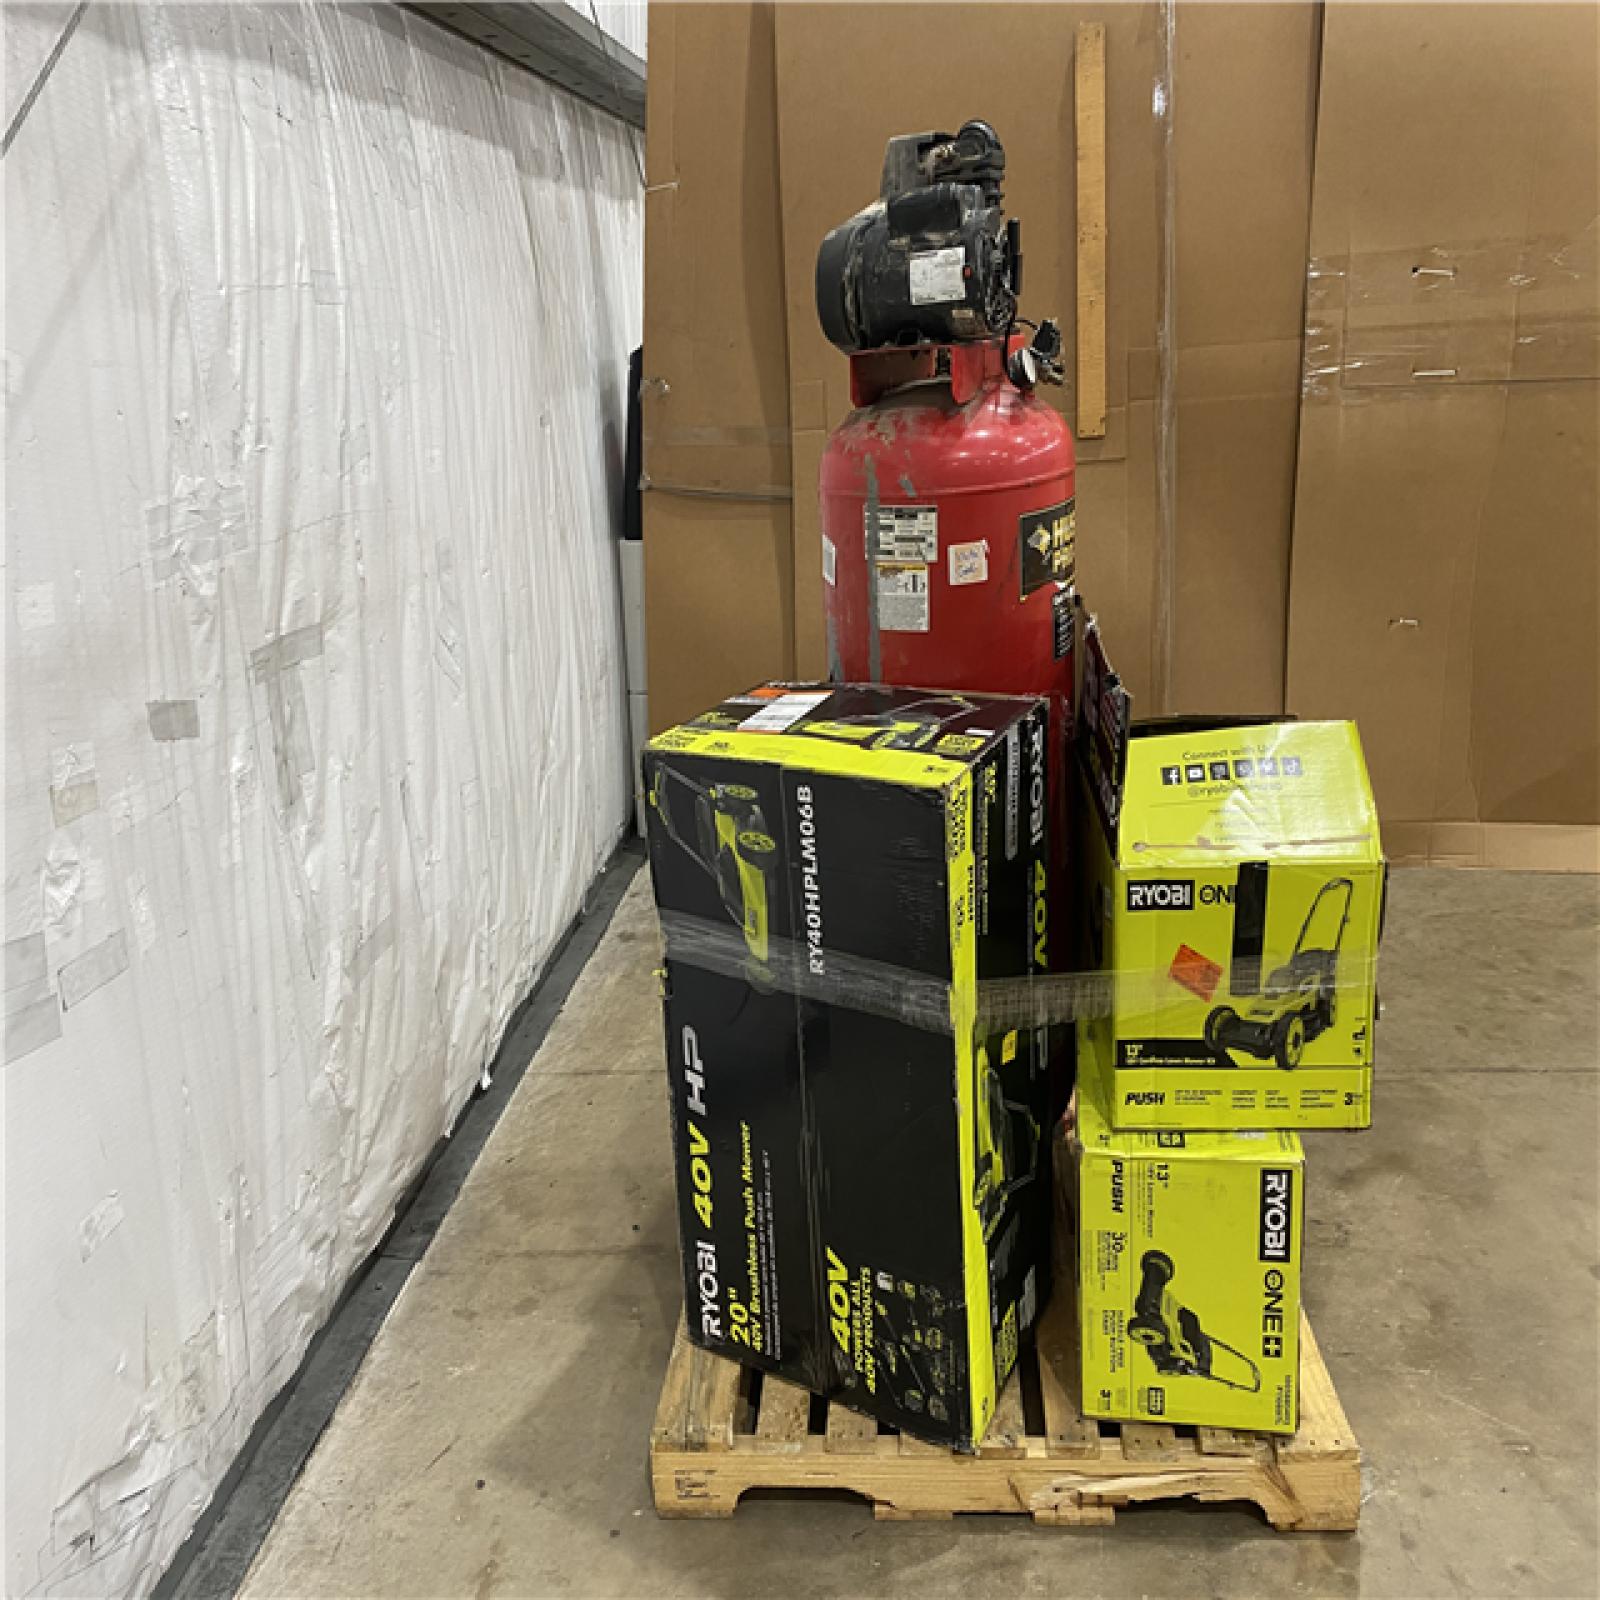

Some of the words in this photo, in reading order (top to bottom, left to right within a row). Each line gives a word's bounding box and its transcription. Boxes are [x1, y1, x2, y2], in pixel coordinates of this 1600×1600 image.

[1033, 860, 1049, 968] 40V
[1128, 884, 1192, 907] RYOBI
[681, 1024, 707, 1116] HP
[1125, 1092, 1166, 1106] PUSH
[687, 1120, 714, 1230] 40V
[739, 1120, 754, 1182] Mower
[1111, 1159, 1124, 1213] PUSH
[742, 1187, 757, 1229] Push
[1264, 1172, 1287, 1257] RYOBI
[696, 1240, 721, 1337] RYOBI
[727, 1287, 751, 1346] 20"
[824, 1244, 851, 1354] 40V
